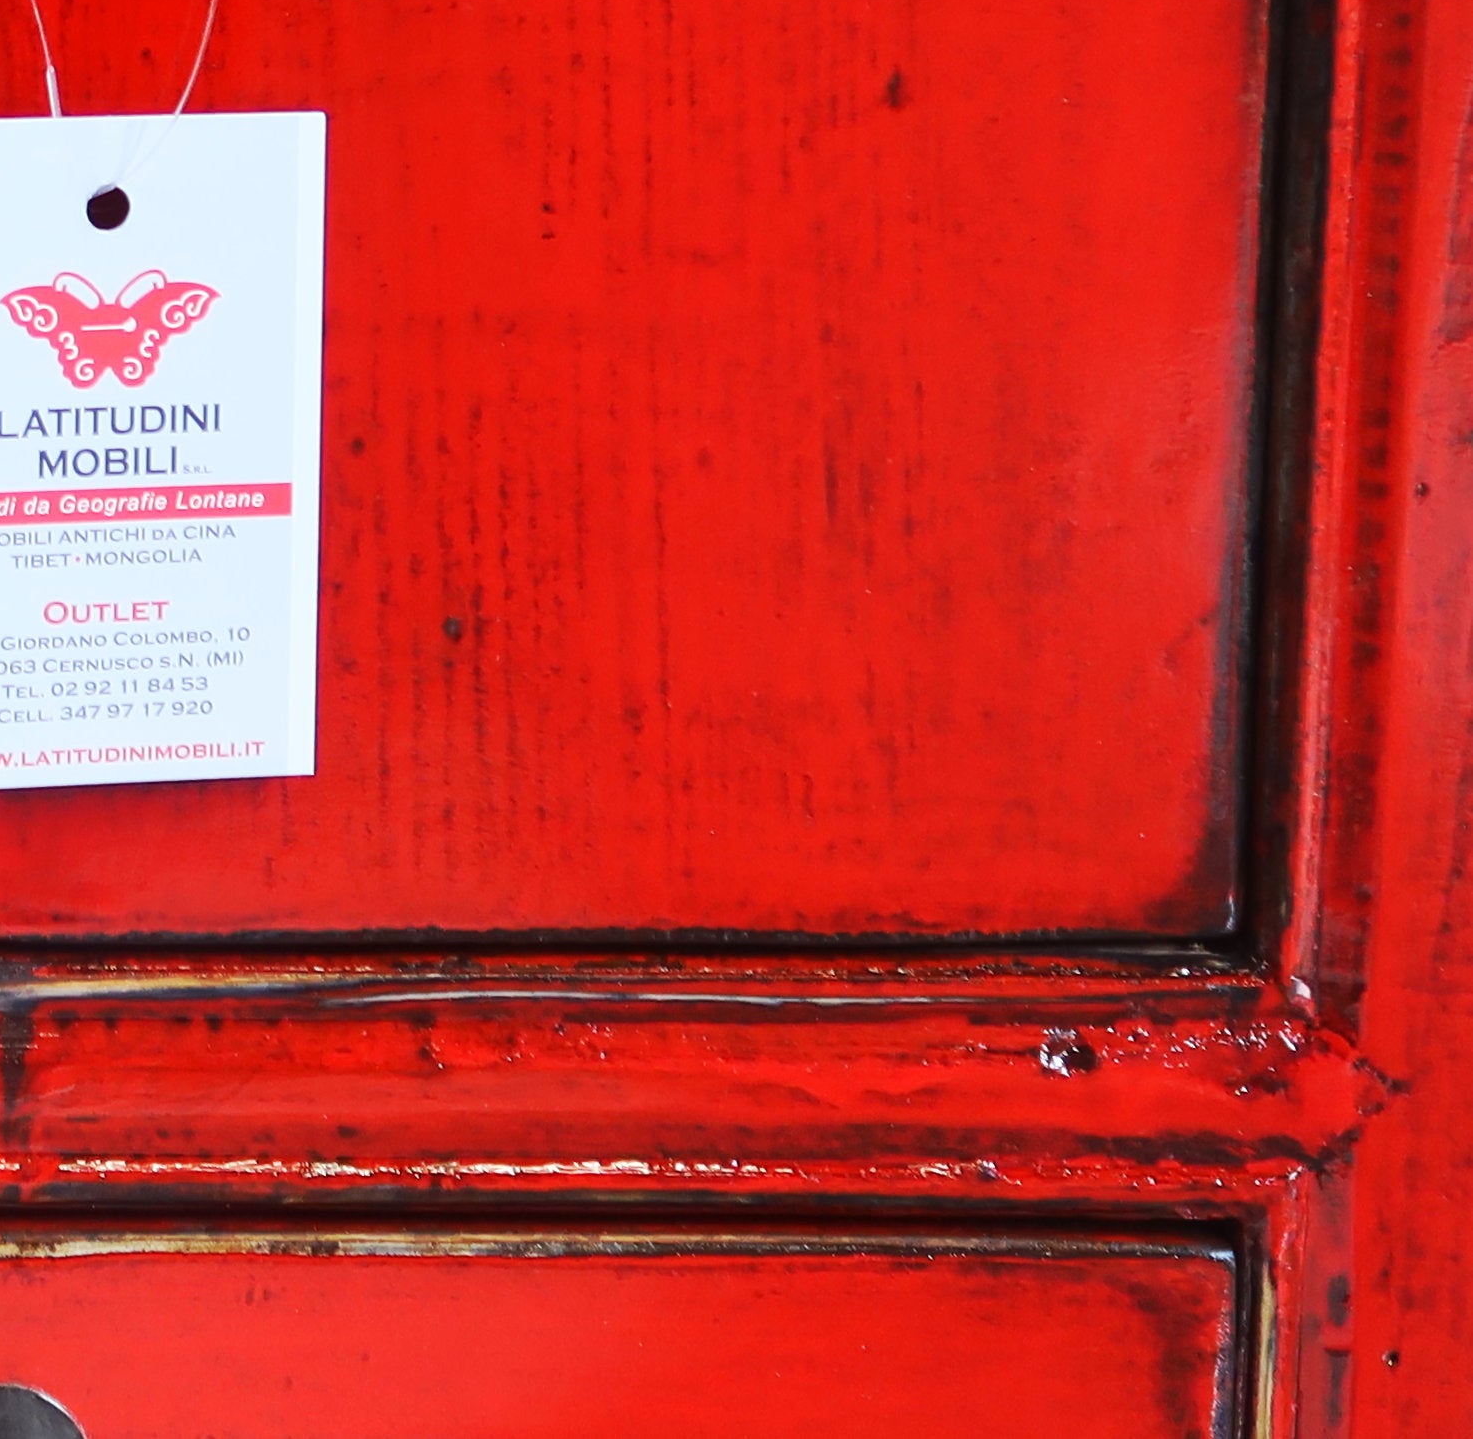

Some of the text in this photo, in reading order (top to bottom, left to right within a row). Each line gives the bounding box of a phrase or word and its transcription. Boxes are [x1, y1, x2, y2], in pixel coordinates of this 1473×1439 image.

[38, 445, 178, 479] MOBILI
[24, 496, 49, 515] da
[59, 489, 167, 515] Geografie
[175, 489, 265, 511] Lontane
[58, 527, 146, 544] ANTICHI
[182, 525, 236, 540] CINA
[227, 627, 250, 642] 10
[207, 651, 244, 667] (MI)
[51, 682, 78, 697] 02
[84, 680, 112, 695] 92
[121, 679, 138, 694] 11
[148, 677, 174, 693] 84
[181, 676, 208, 691] 53
[60, 705, 101, 721] 347
[107, 704, 134, 719] 97
[143, 702, 165, 717] 17
[172, 700, 213, 715] 920
